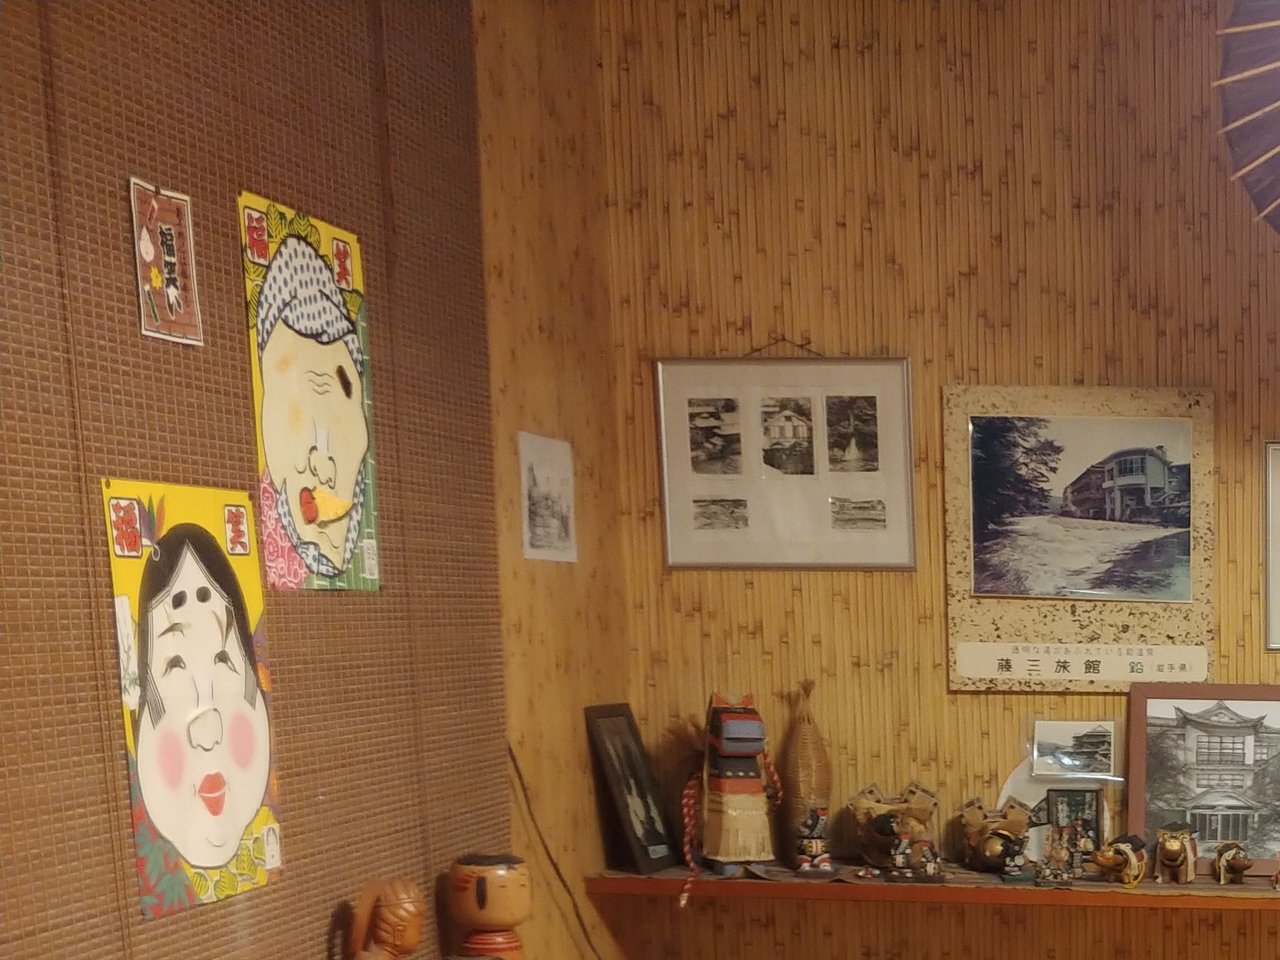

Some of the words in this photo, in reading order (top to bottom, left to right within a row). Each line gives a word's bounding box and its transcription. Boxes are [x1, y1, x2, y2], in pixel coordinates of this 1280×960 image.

[996, 657, 1101, 675] 藤三旅館
[1128, 661, 1144, 674] 鉛
